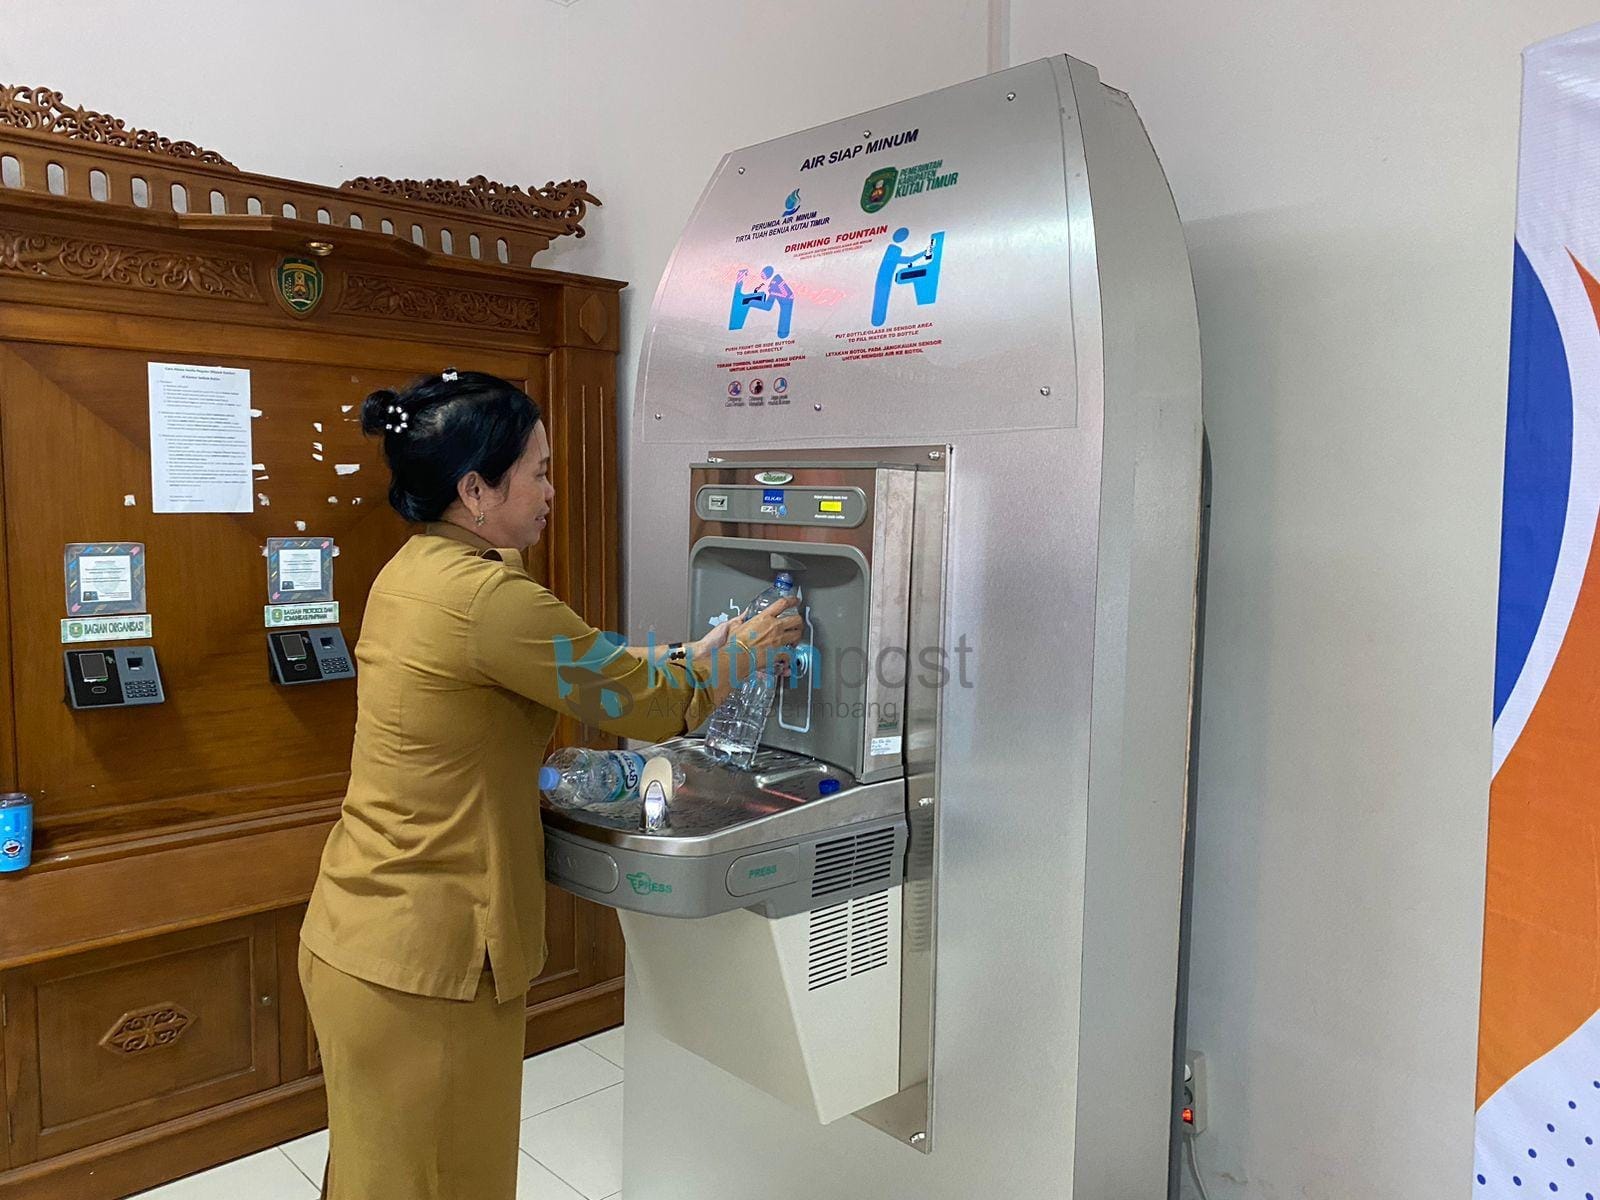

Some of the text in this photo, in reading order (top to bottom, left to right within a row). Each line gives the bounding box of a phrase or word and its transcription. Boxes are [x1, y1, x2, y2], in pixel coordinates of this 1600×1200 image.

[800, 129, 919, 171] AIR SIAP MINUM
[895, 172, 959, 199] KUTAI TIMUR
[735, 217, 830, 243] TIRTA TUAH BENUA KUTAI TIMUR
[751, 211, 817, 231] PERUMDA AIR MINUM
[784, 237, 831, 253] DRINKING
[835, 225, 888, 243] FOUNTAIN
[84, 621, 144, 635] BAGIAN ORGANISASI
[749, 864, 777, 879] PRESS
